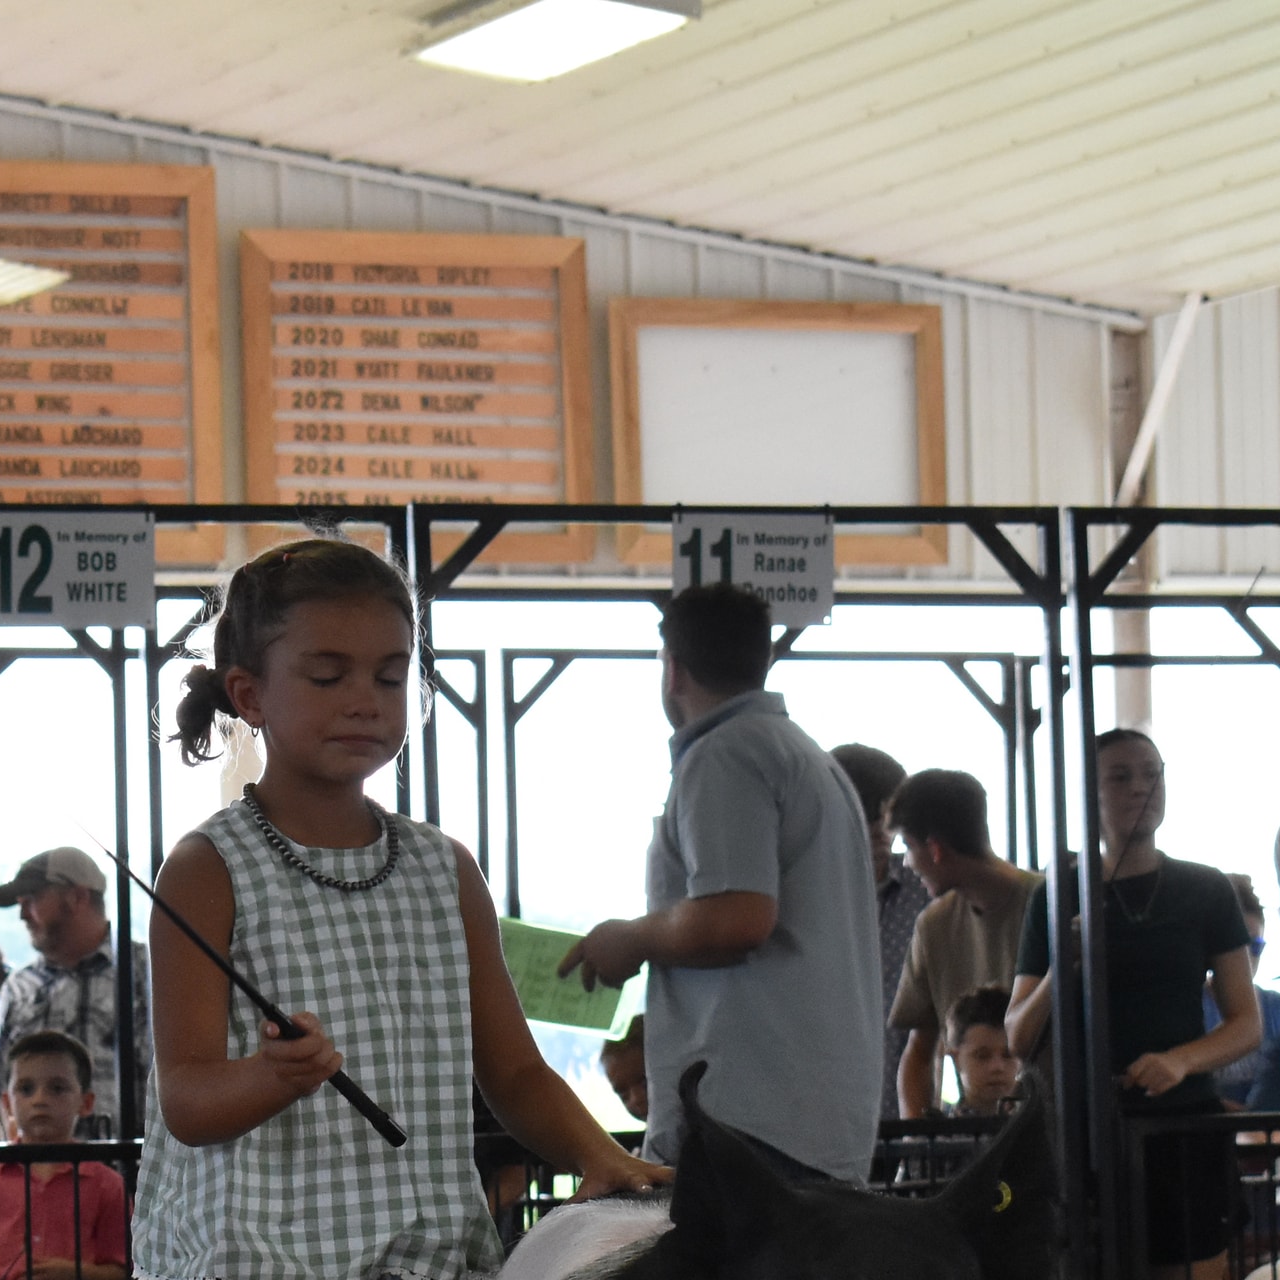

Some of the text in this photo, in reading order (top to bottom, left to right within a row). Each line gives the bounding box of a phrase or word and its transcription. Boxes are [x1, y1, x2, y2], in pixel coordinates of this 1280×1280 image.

[289, 262, 334, 280] 2018
[290, 296, 334, 314] 2019
[292, 326, 343, 345] 2020
[292, 359, 337, 378] 2021
[292, 390, 344, 410] 2022
[294, 423, 477, 446] 2023 CALE HALL
[294, 456, 345, 475] 2024
[57, 531, 147, 544] In Memory of
[737, 533, 827, 549] In Memory of
[78, 552, 117, 571] BOB
[680, 528, 732, 590] 11
[754, 553, 806, 572] Ranae
[67, 583, 127, 603] WHITE
